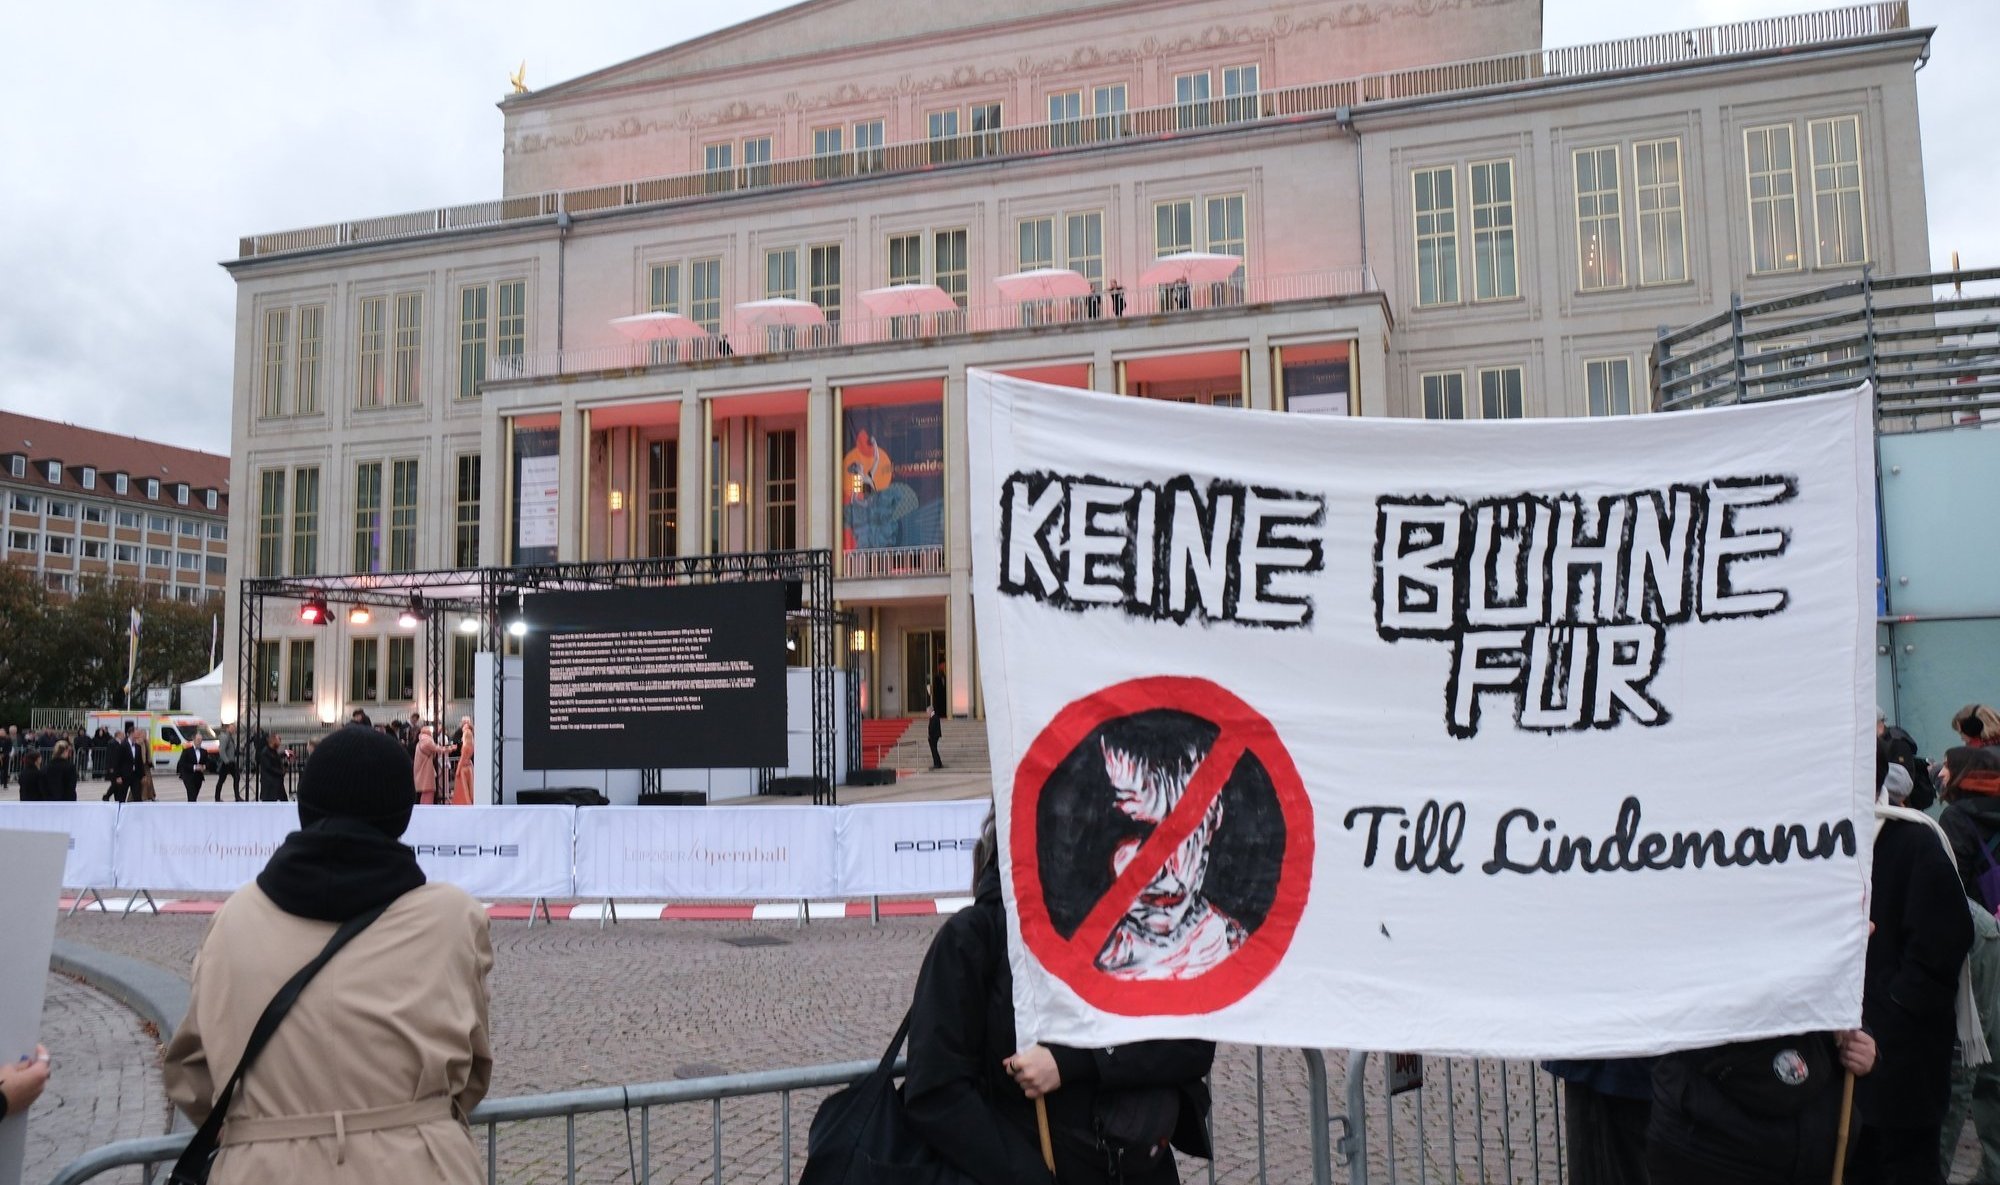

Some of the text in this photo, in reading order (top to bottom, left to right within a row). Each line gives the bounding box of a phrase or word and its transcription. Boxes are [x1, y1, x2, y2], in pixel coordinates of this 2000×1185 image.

[998, 470, 1799, 640] KEINE BÜHNE
[1444, 622, 1673, 740] FÜR
[411, 844, 519, 857] RSCHE
[895, 838, 977, 853] PORS
[1344, 796, 1858, 875] Till Lindemann
